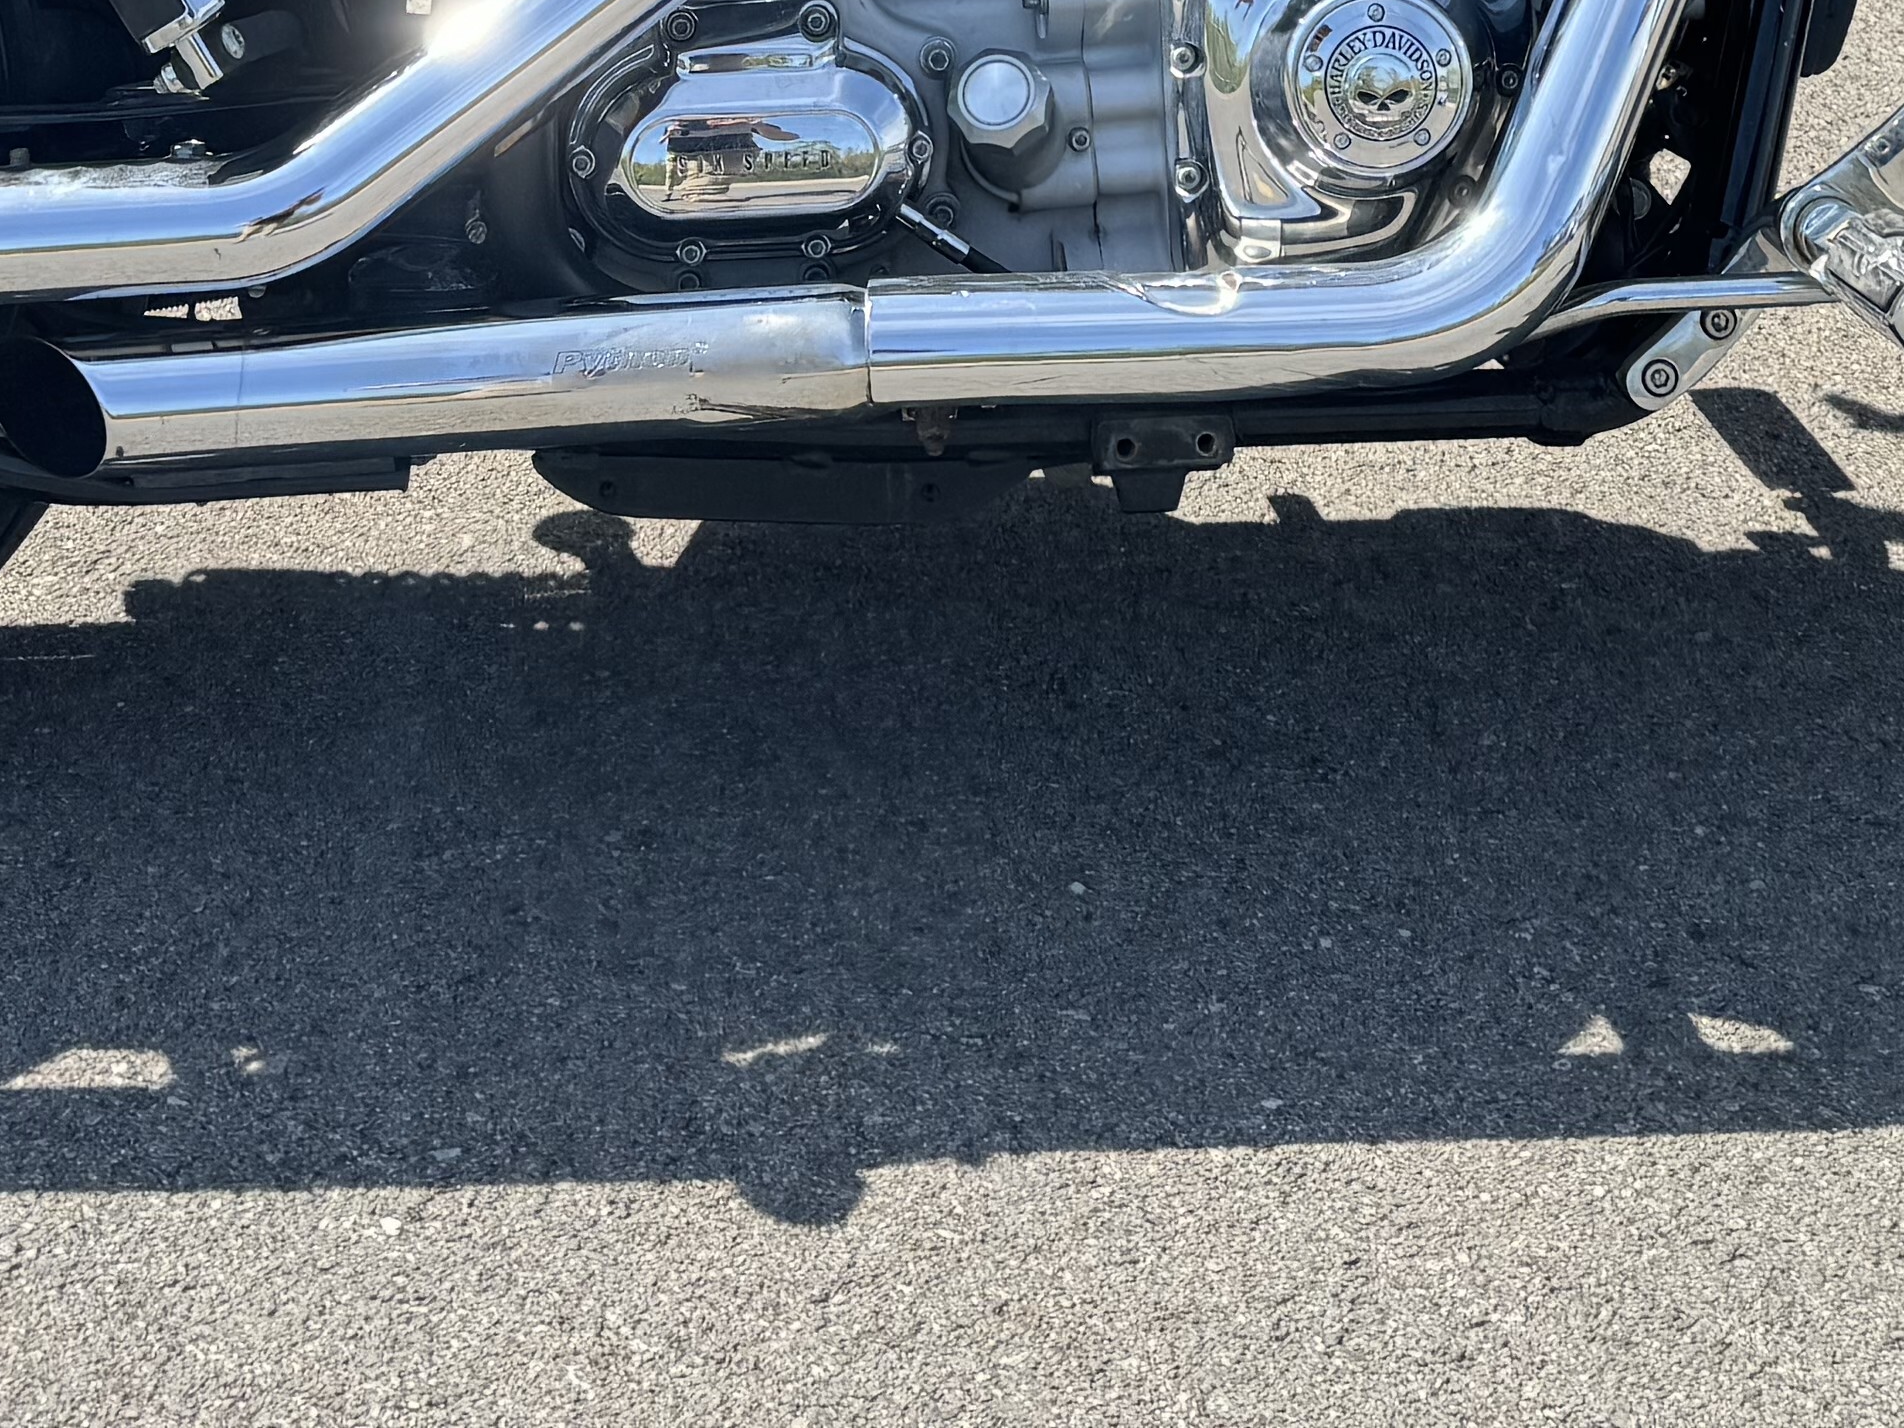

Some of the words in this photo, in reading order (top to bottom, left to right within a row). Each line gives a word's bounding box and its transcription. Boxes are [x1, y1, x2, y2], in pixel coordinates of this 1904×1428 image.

[1330, 30, 1434, 96] HARLEY-DAVIDSON
[677, 153, 725, 177] SIX
[742, 150, 831, 173] SPEED
[552, 346, 690, 380] Python
